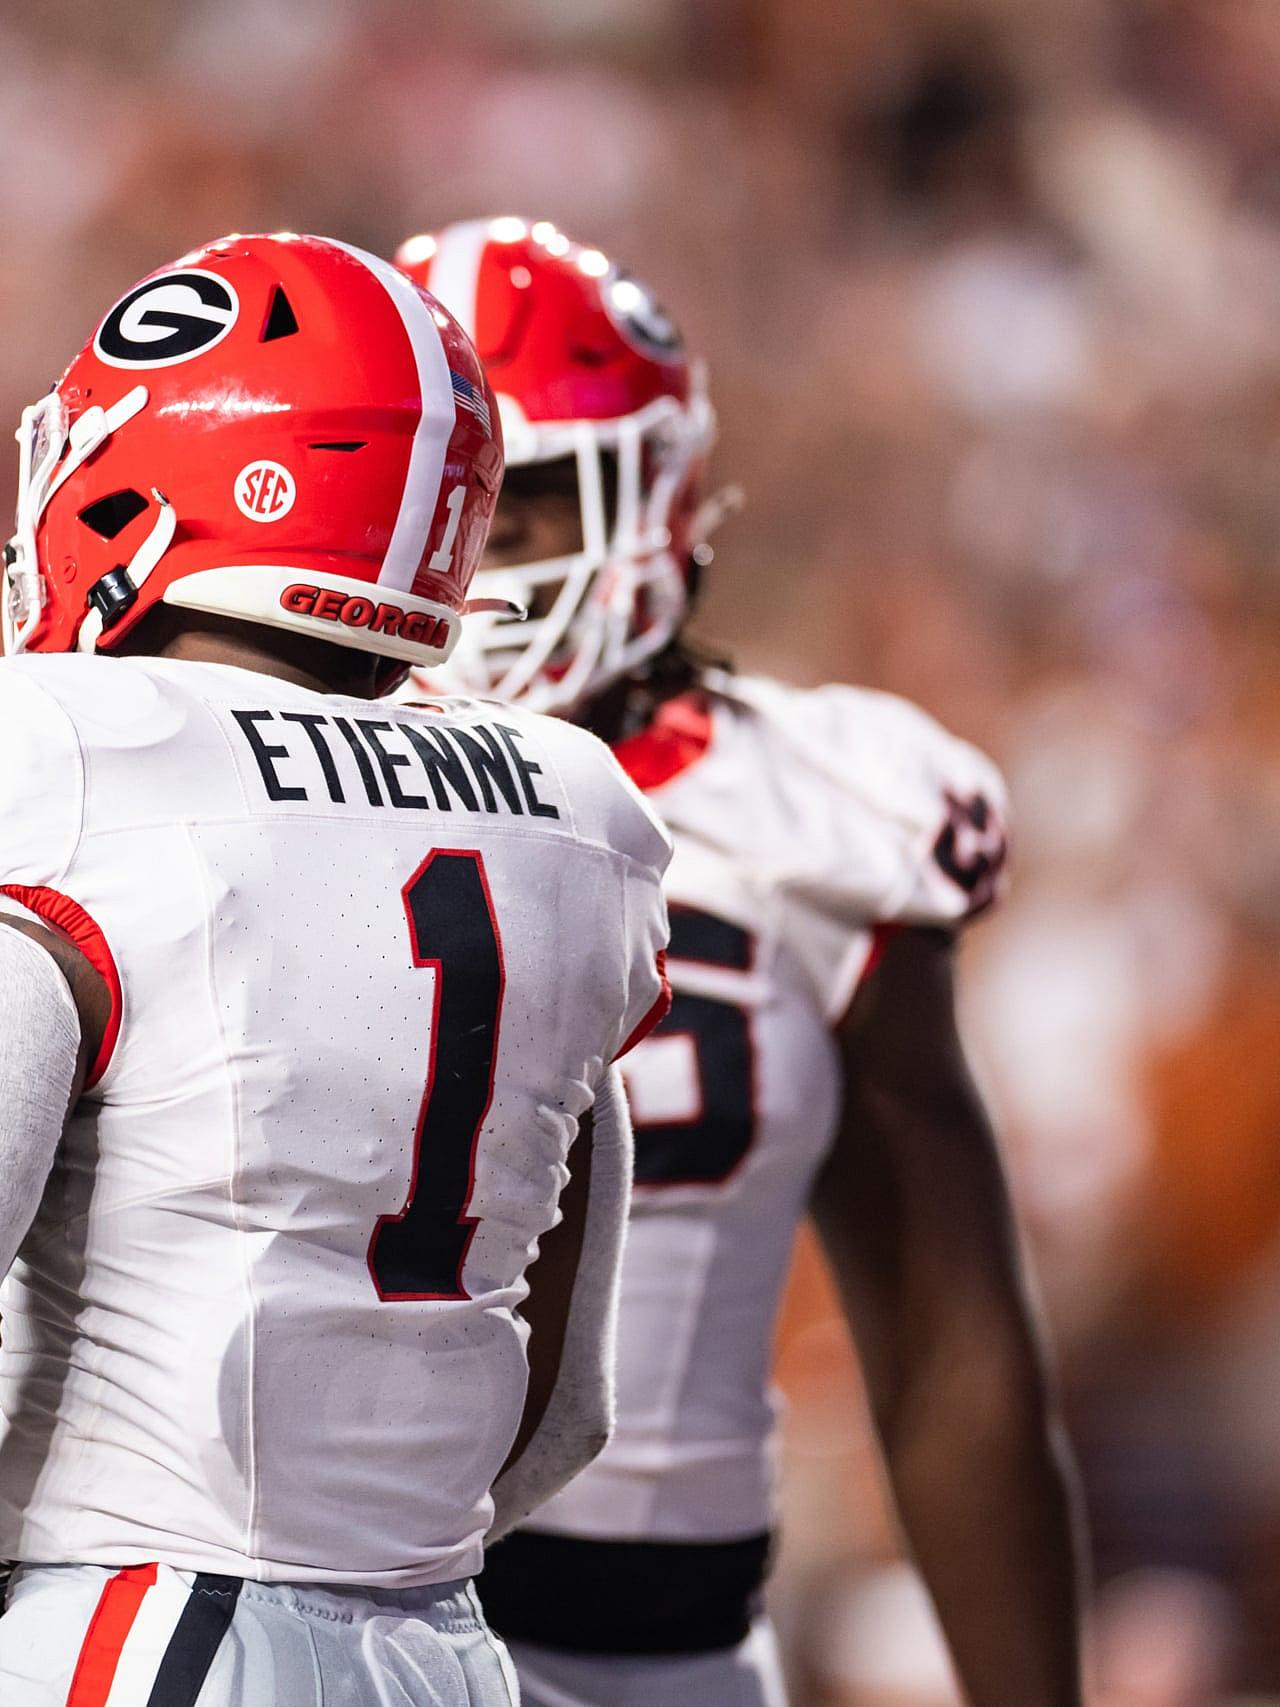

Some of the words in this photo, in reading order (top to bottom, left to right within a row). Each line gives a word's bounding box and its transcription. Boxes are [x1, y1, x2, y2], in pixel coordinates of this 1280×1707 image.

[99, 274, 232, 361] G
[242, 468, 288, 514] SEC
[428, 485, 467, 573] 1
[280, 583, 450, 649] GEORGIA
[231, 709, 560, 819] ETIENNE
[367, 847, 506, 1302] 1
